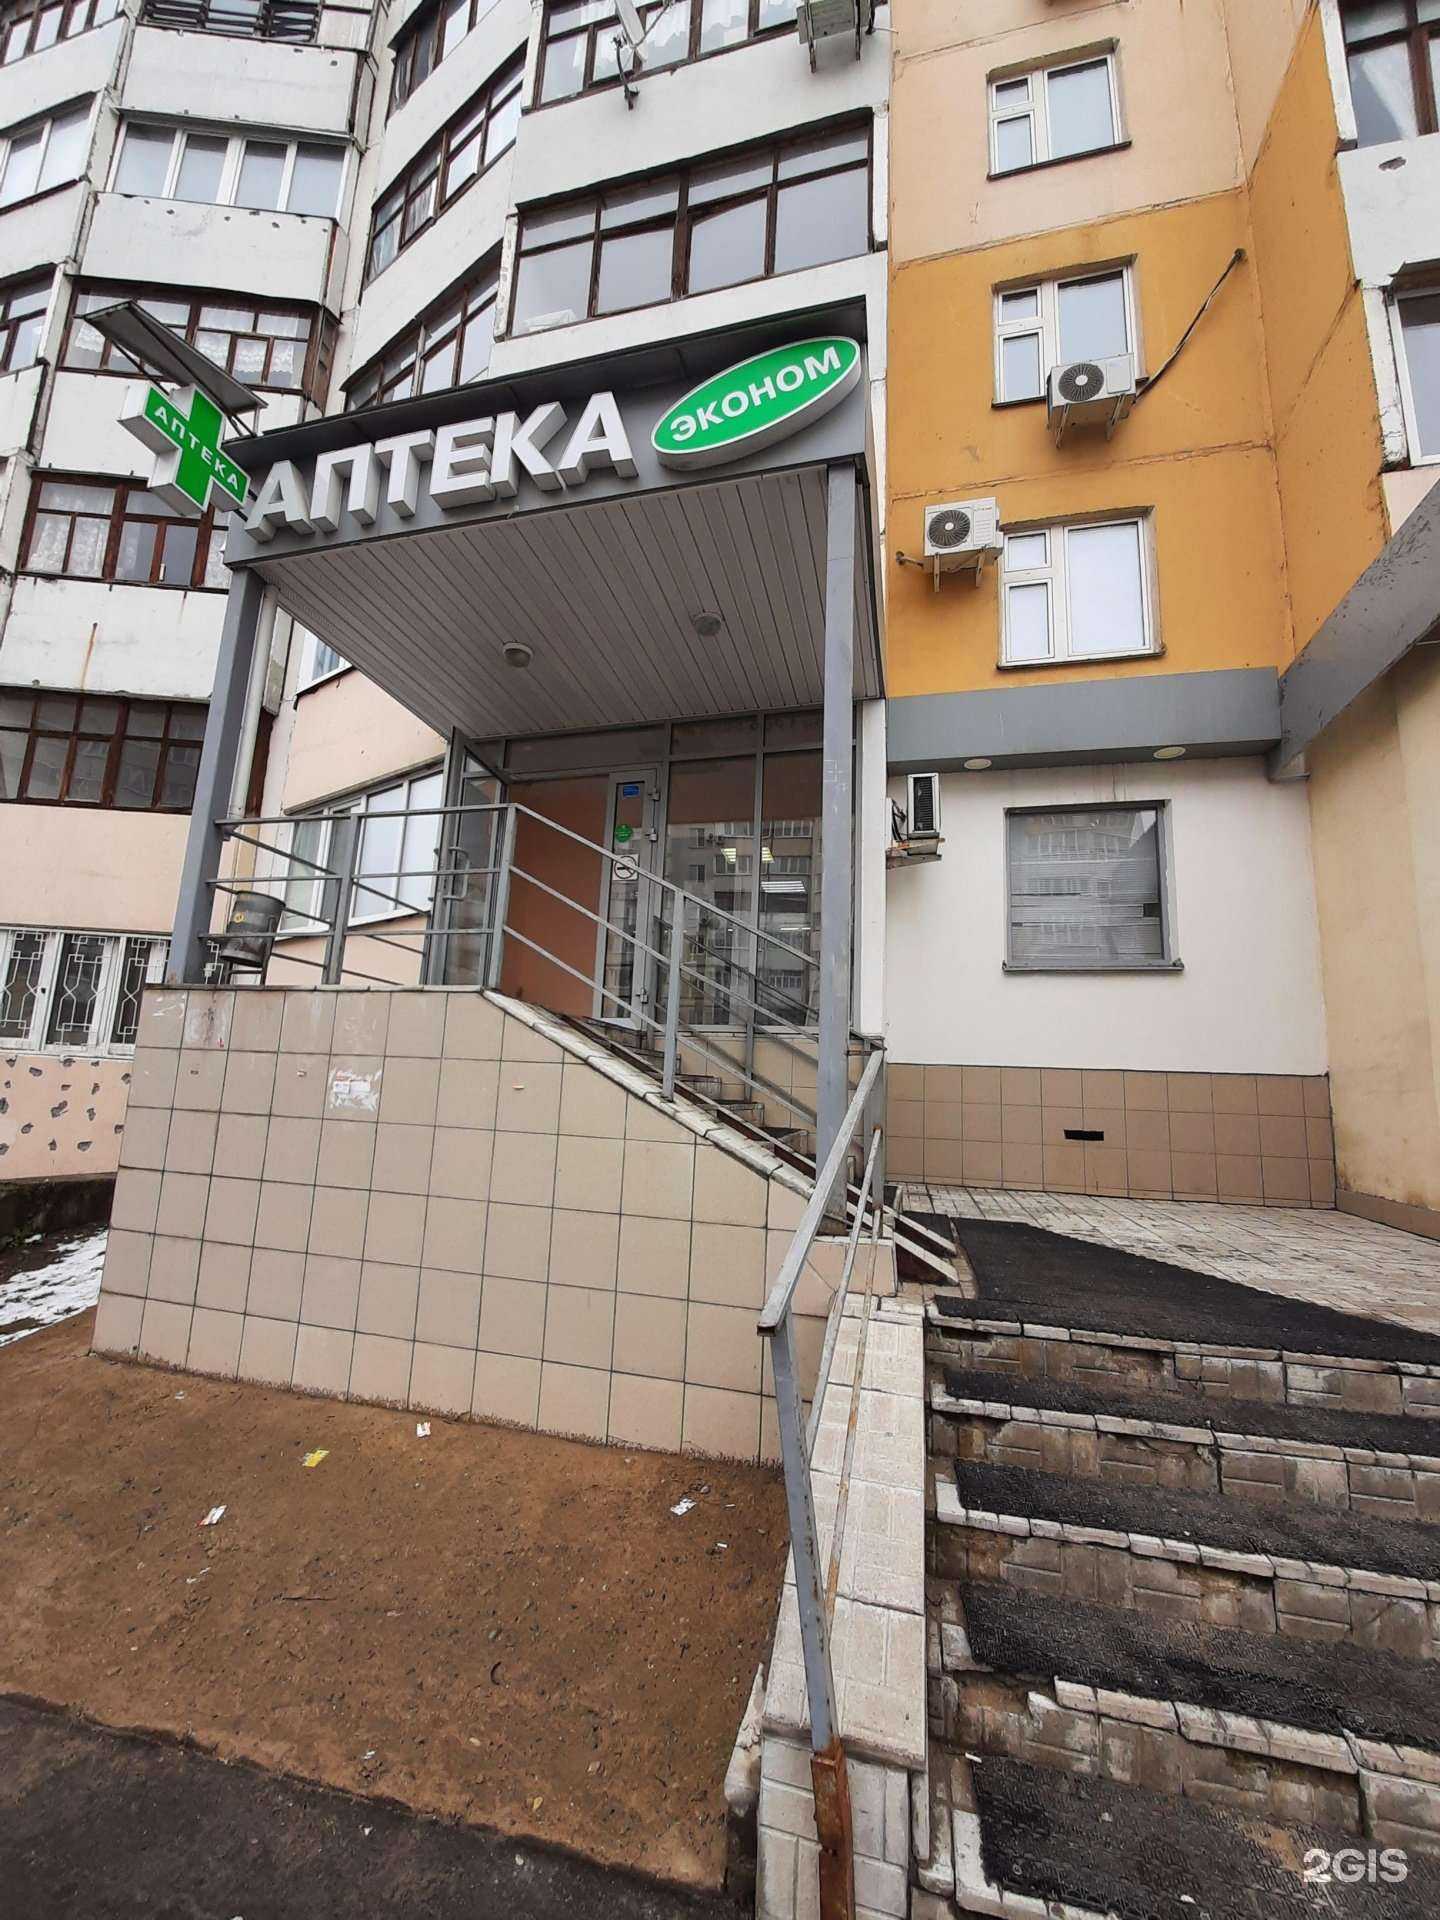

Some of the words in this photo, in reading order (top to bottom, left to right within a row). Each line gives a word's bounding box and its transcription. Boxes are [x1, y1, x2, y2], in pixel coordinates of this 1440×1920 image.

[670, 346, 842, 442] ЭКОНОМ
[154, 405, 239, 491] АПТЕКА
[244, 391, 638, 542] АПТЕКА
